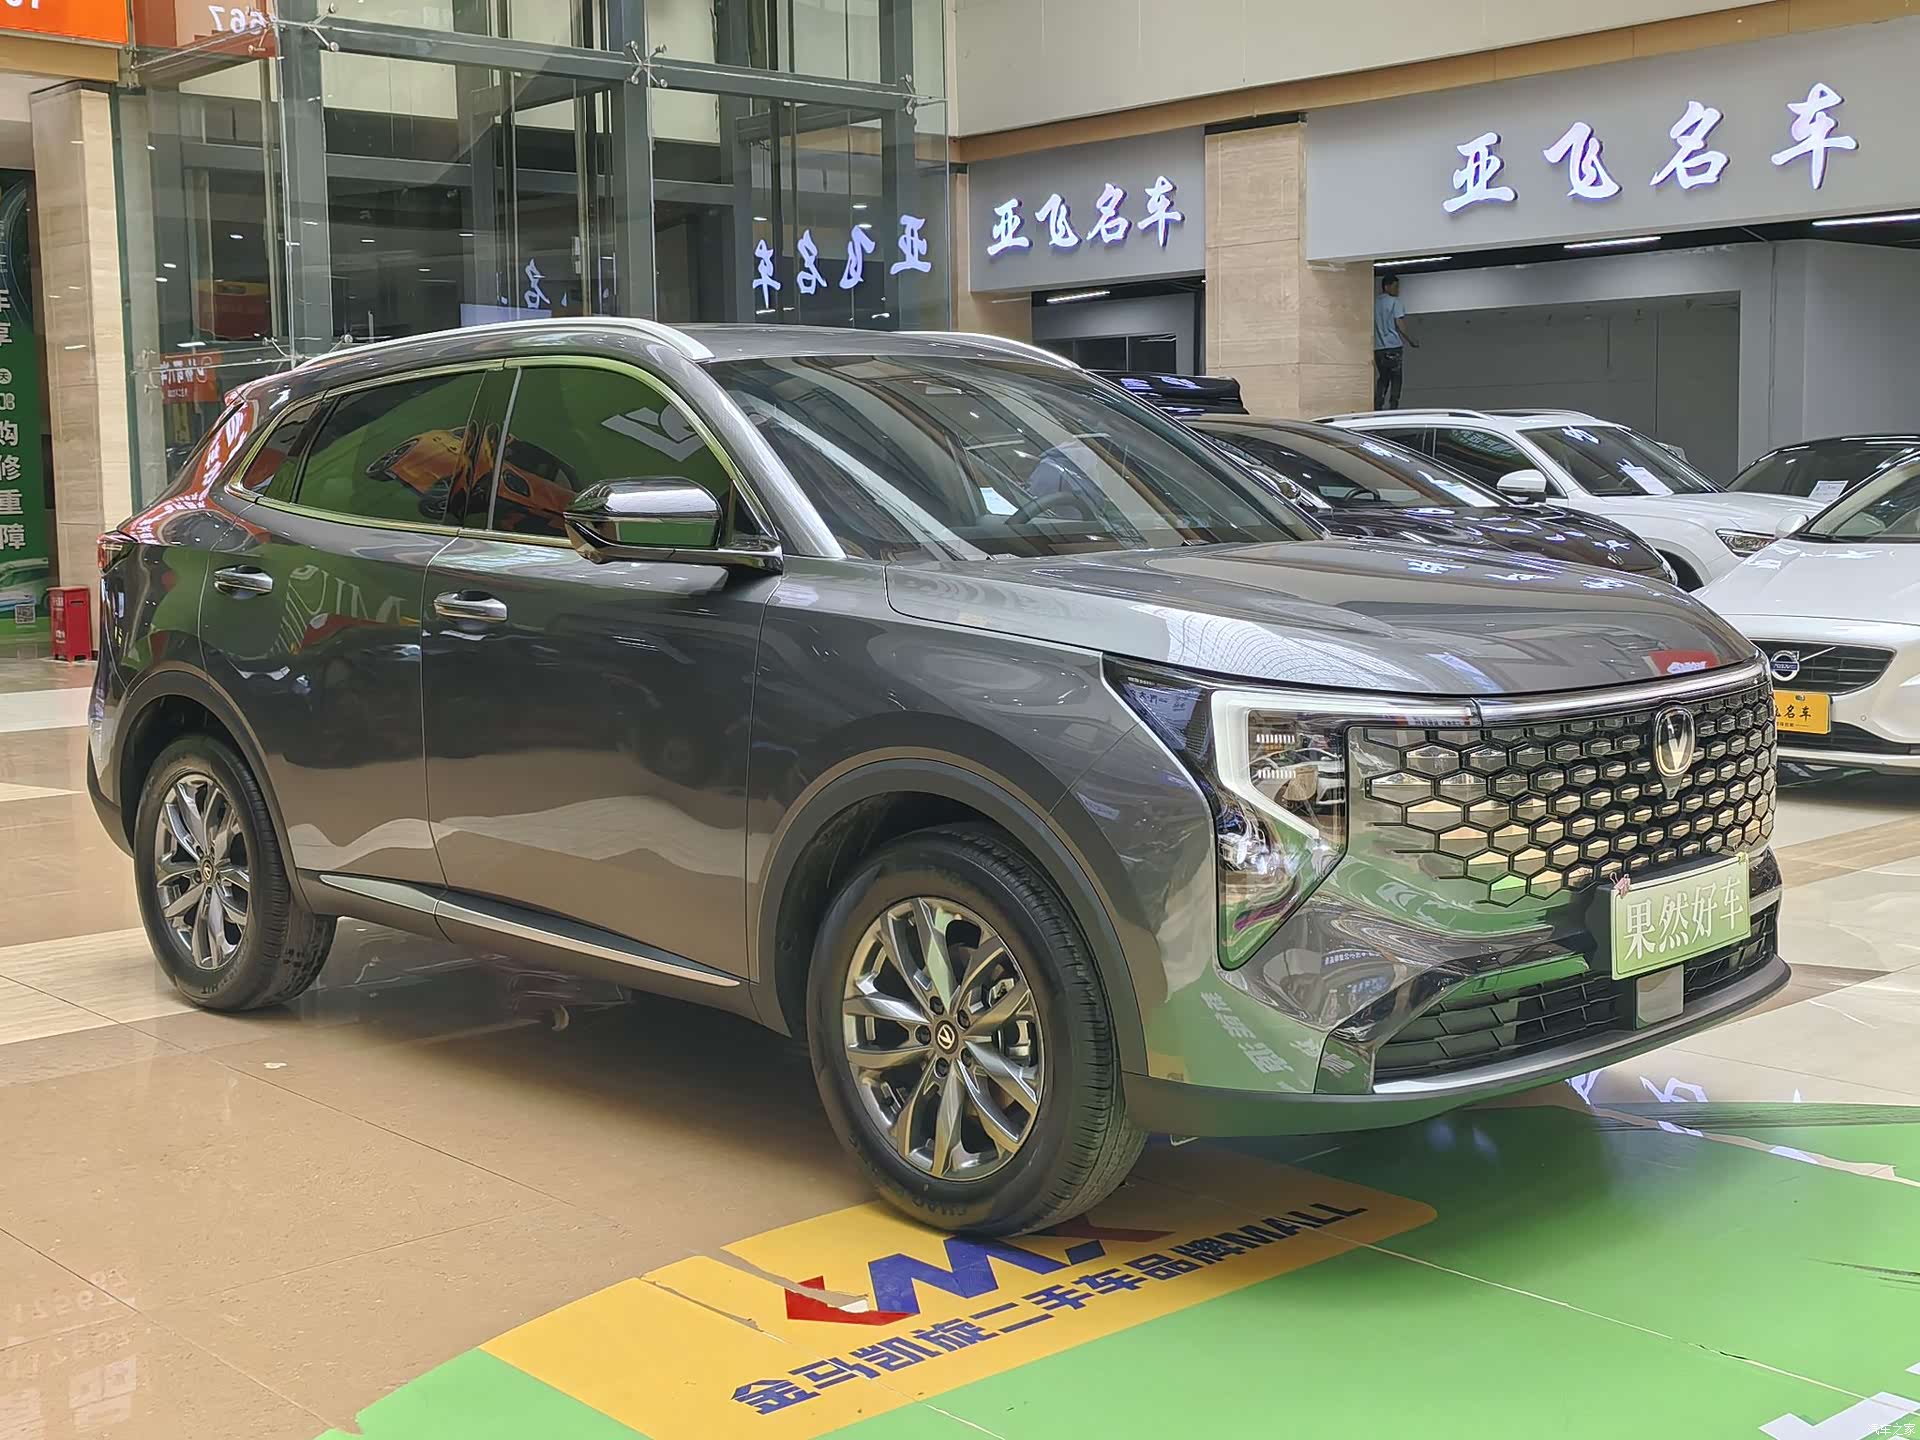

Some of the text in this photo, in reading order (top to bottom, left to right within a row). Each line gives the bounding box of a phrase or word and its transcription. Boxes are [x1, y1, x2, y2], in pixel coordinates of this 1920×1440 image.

[1443, 82, 1858, 213] 亚飞名车
[987, 176, 1185, 255] 亚飞名车
[1624, 876, 1744, 961] 果然好车
